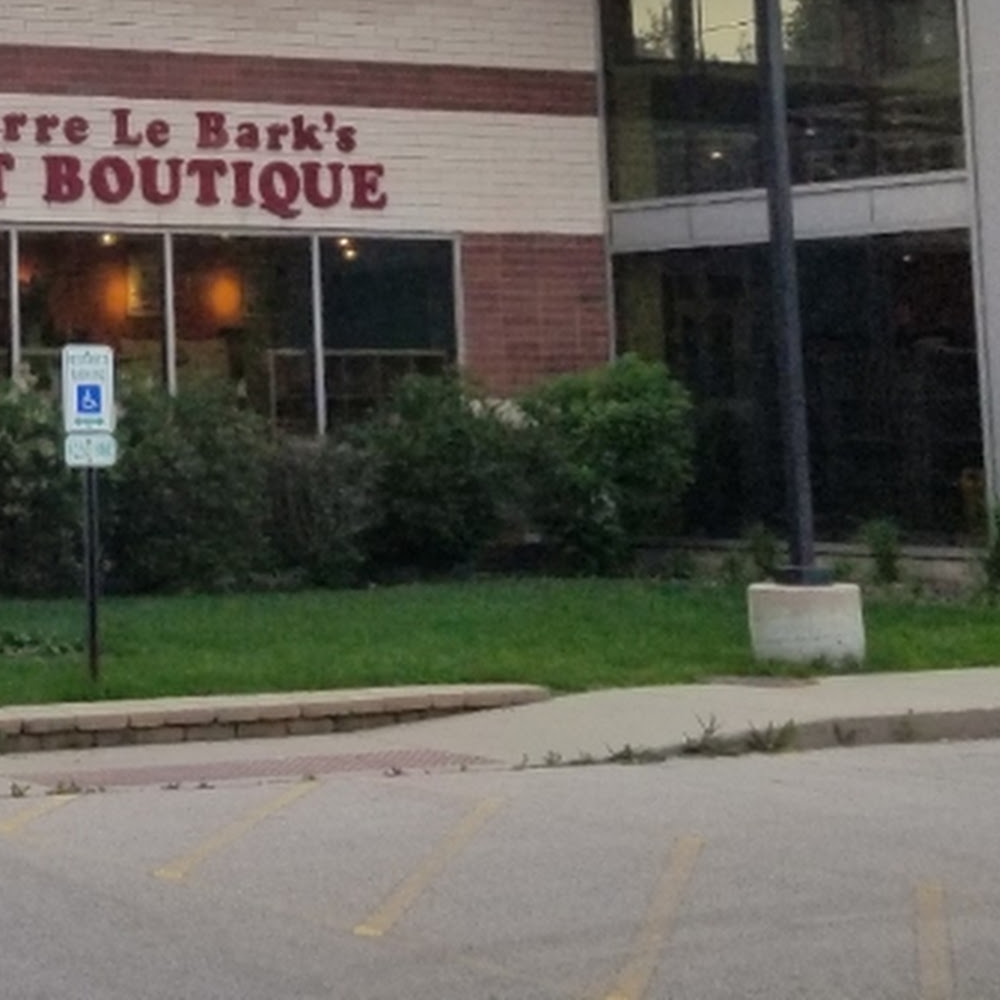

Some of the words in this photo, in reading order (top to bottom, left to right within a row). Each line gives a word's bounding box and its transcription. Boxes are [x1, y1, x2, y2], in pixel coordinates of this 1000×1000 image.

[112, 108, 170, 148] Le
[195, 111, 359, 153] Bark's
[41, 154, 389, 220] BOUTIQUE
